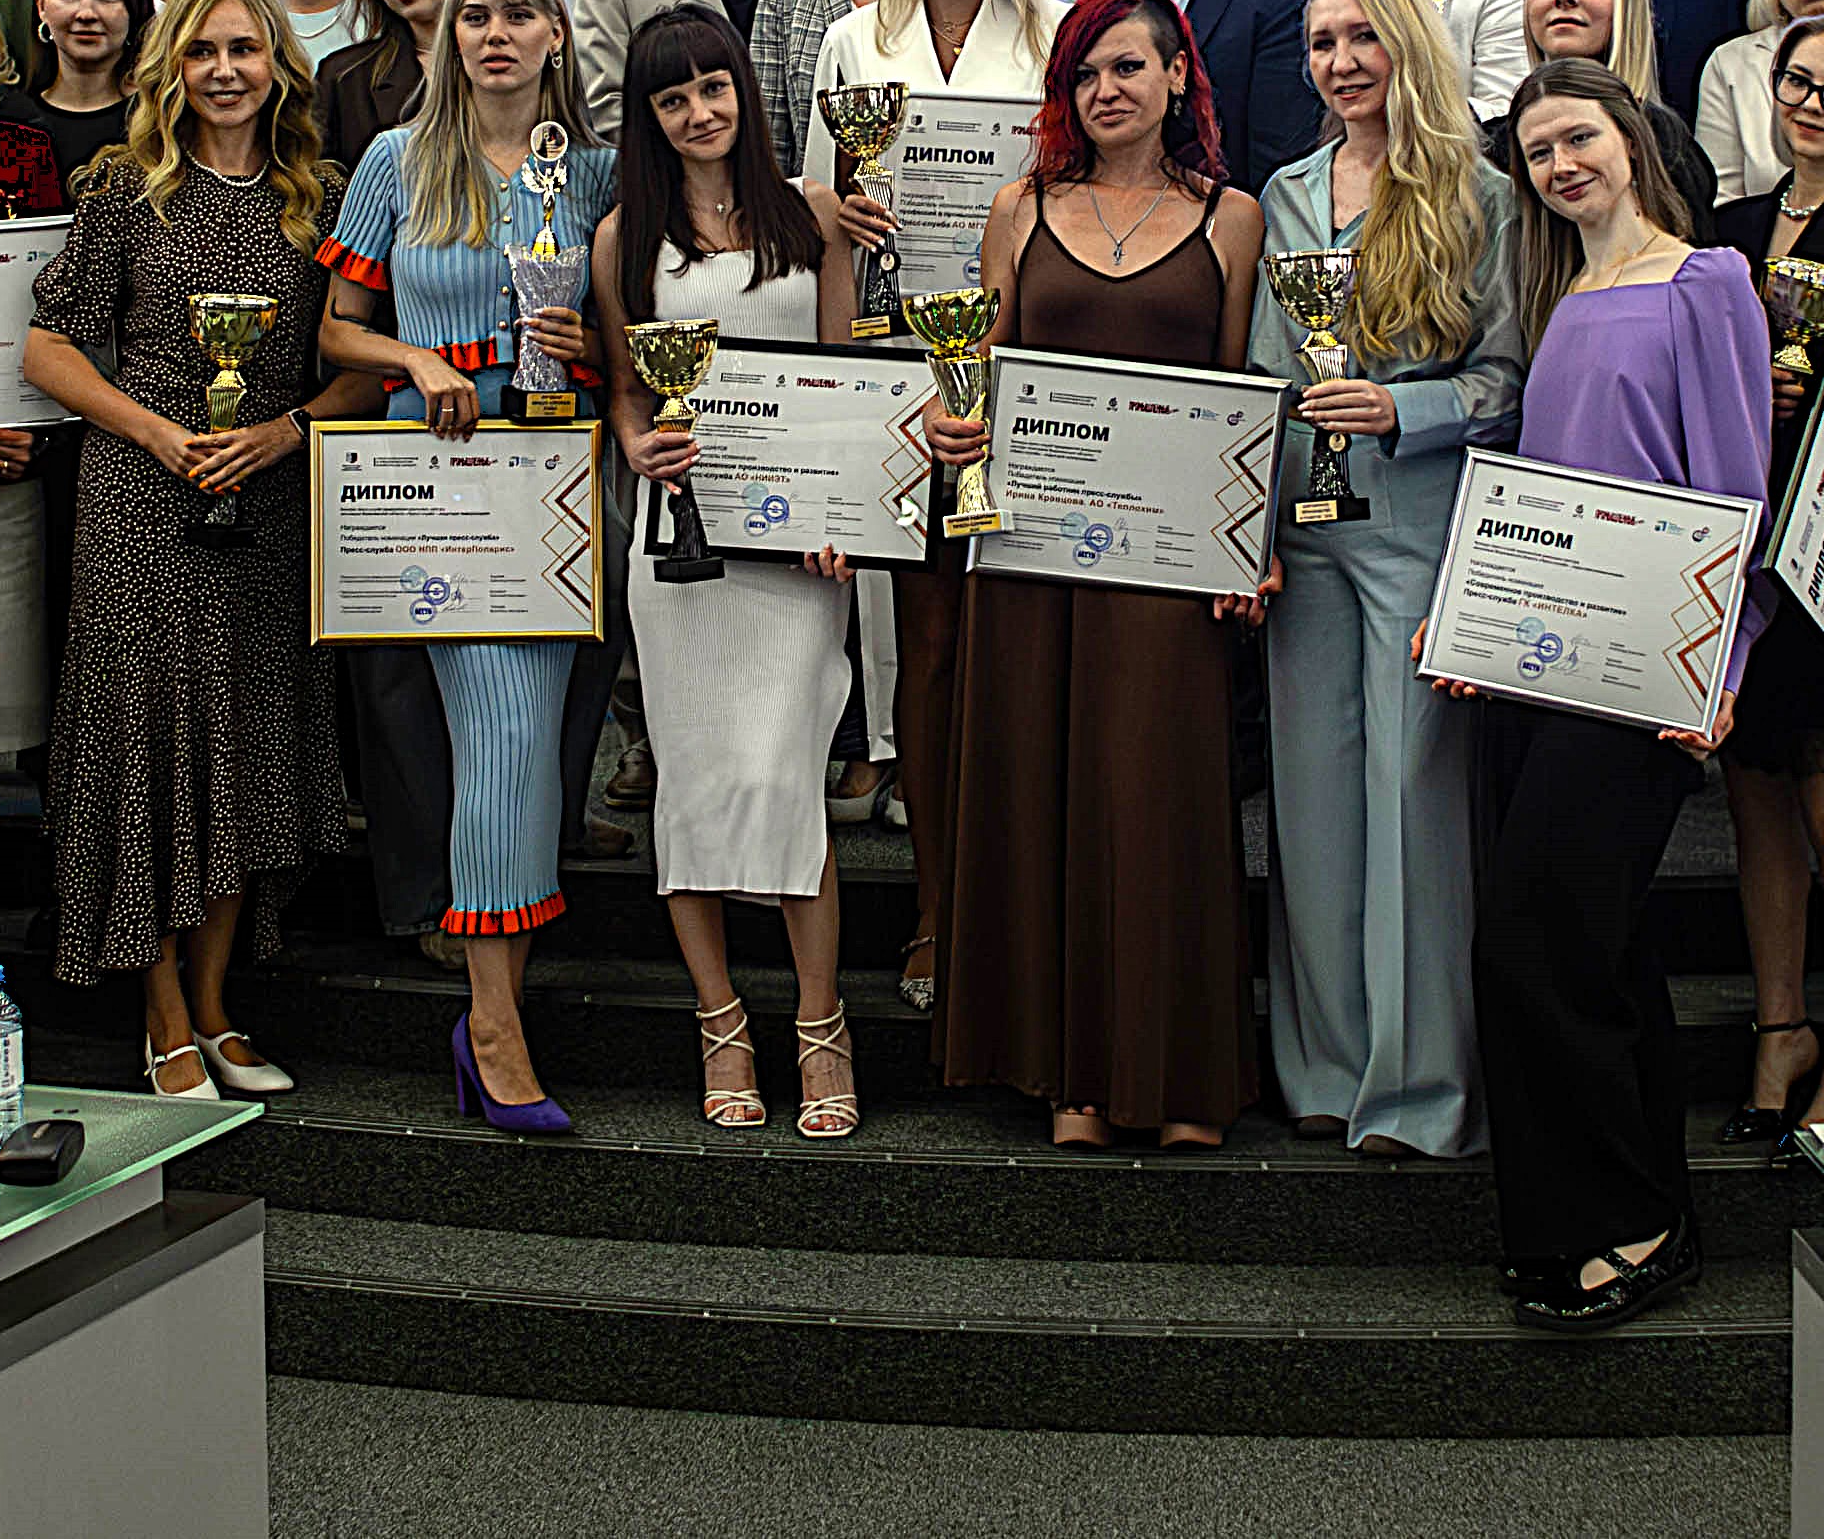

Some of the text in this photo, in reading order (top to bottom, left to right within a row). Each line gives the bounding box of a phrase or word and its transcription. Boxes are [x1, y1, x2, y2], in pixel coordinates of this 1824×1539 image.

[905, 146, 994, 165] ДИПЛОМ
[1012, 417, 1110, 441] ДИПЛОМ
[340, 485, 434, 503] ДИПЛОМ
[1477, 518, 1574, 550] ДИПЛОМ
